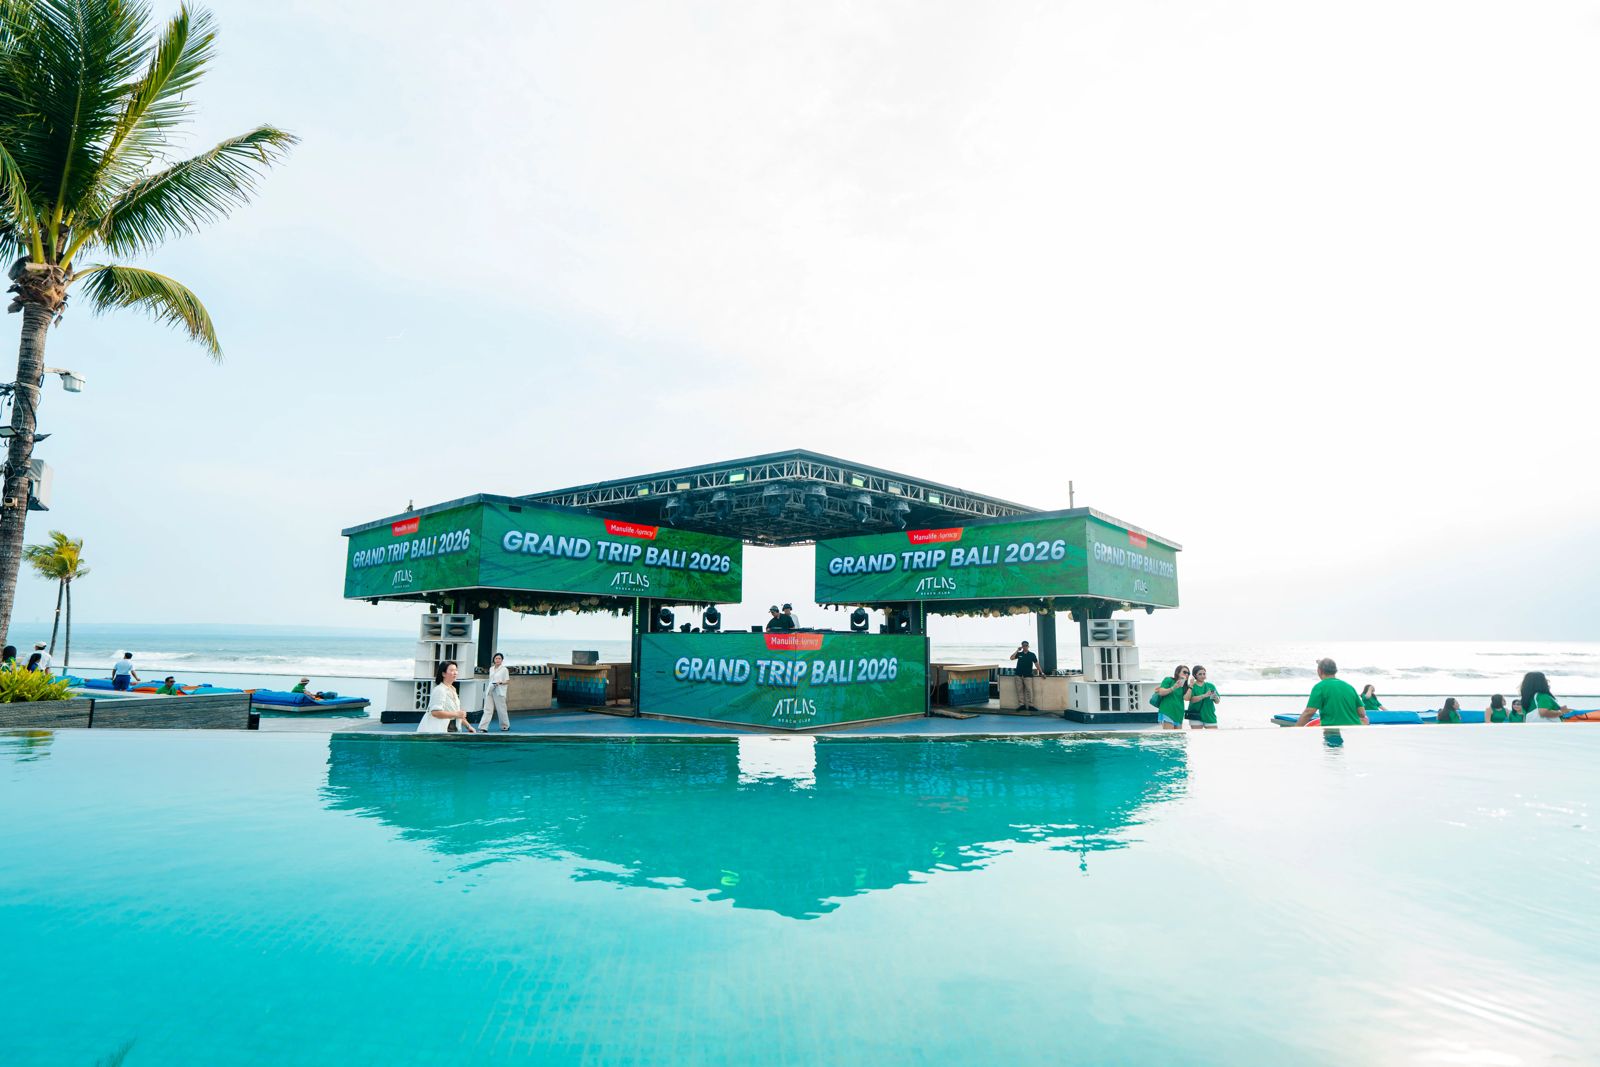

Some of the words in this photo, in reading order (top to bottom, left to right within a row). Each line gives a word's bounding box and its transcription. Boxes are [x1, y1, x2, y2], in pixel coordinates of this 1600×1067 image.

[611, 524, 635, 533] Manulife
[913, 533, 937, 541] Manulife
[353, 546, 385, 568] GRAND
[387, 541, 410, 562] TRIP
[410, 535, 437, 559] BALI
[438, 528, 471, 554] 2026
[503, 530, 591, 558] GRAND
[597, 541, 642, 563] TRIP
[645, 547, 687, 569] BALI
[689, 552, 731, 573] 2026
[829, 553, 896, 574] GRAND
[901, 549, 946, 570] TRIP
[950, 545, 1000, 567] BALI
[1004, 539, 1066, 563] 2026
[1094, 541, 1125, 566] GRAND
[1126, 550, 1143, 570] TRIP
[1143, 556, 1159, 575] BALI
[1159, 561, 1174, 577] 2026
[391, 569, 413, 586] ATLAS
[610, 571, 650, 588] ATLAS
[915, 576, 957, 592] ATLAS
[771, 637, 798, 645] Manulife
[675, 657, 750, 682] GRAND
[757, 660, 807, 686] TRIP
[810, 660, 854, 684] BALI
[857, 657, 898, 680] 2026
[772, 698, 817, 717] ATLAS
